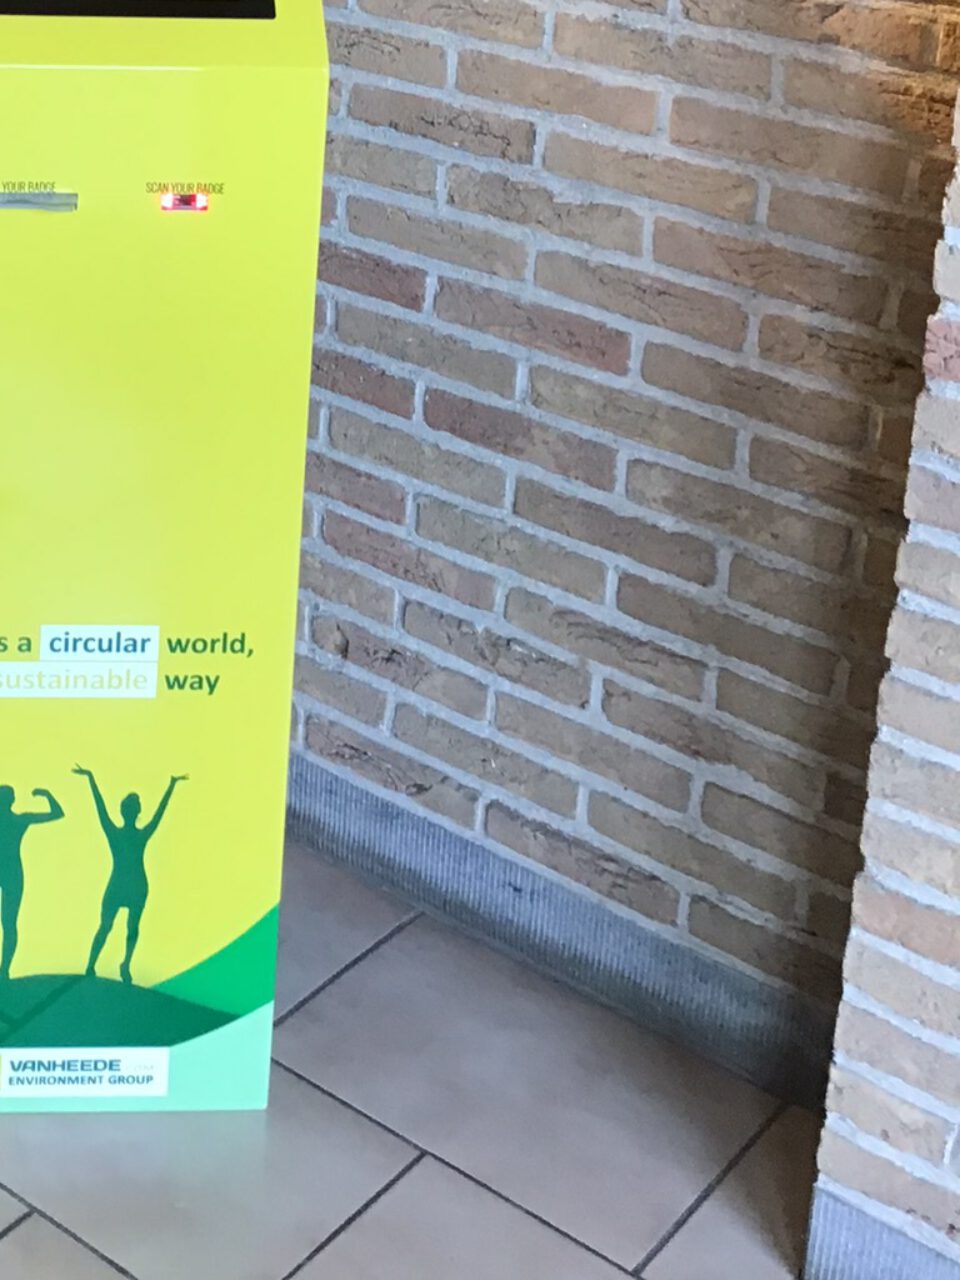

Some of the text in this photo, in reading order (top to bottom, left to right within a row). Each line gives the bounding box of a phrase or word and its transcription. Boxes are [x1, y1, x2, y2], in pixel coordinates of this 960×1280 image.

[2, 181, 26, 194] YOUR
[145, 182, 225, 195] SCAN YOUR BADGE
[17, 636, 32, 654] a
[49, 631, 151, 654] circular
[167, 632, 254, 658] world,
[164, 673, 220, 696] way
[9, 1059, 121, 1072] VANHEEDE
[8, 1075, 154, 1086] ENVIRONMENT GROUP
